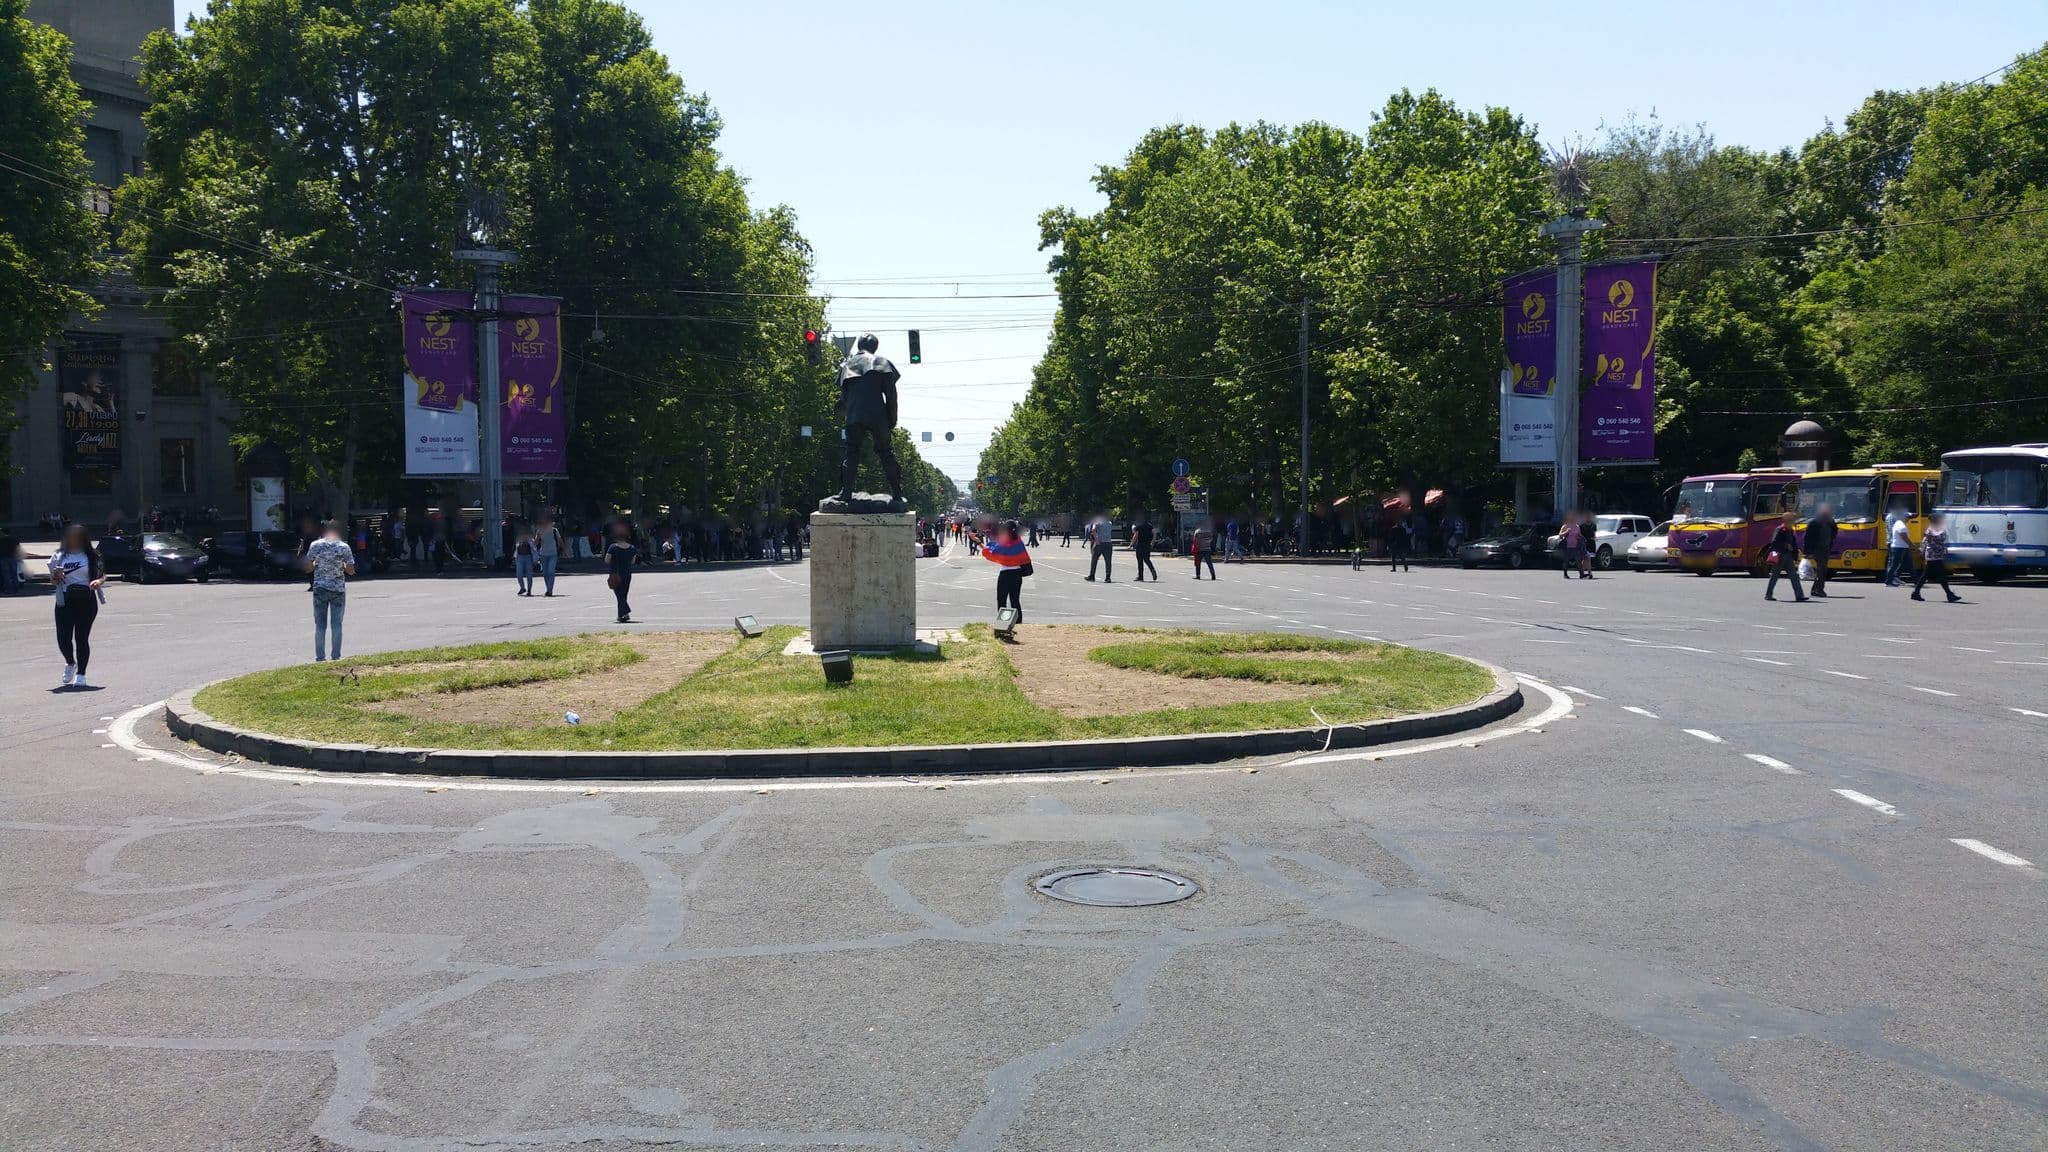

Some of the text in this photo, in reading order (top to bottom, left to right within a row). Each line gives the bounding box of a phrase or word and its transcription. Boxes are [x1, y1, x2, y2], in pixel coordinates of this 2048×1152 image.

[1602, 308, 1639, 324] NEST
[1517, 319, 1550, 334] NEST
[420, 336, 456, 350] NEST
[512, 341, 545, 354] NEST
[1607, 372, 1626, 381] NEST
[429, 394, 448, 403] NEST
[75, 431, 104, 447] Lady
[1705, 482, 1714, 492] 12
[64, 561, 80, 569] NIKE
